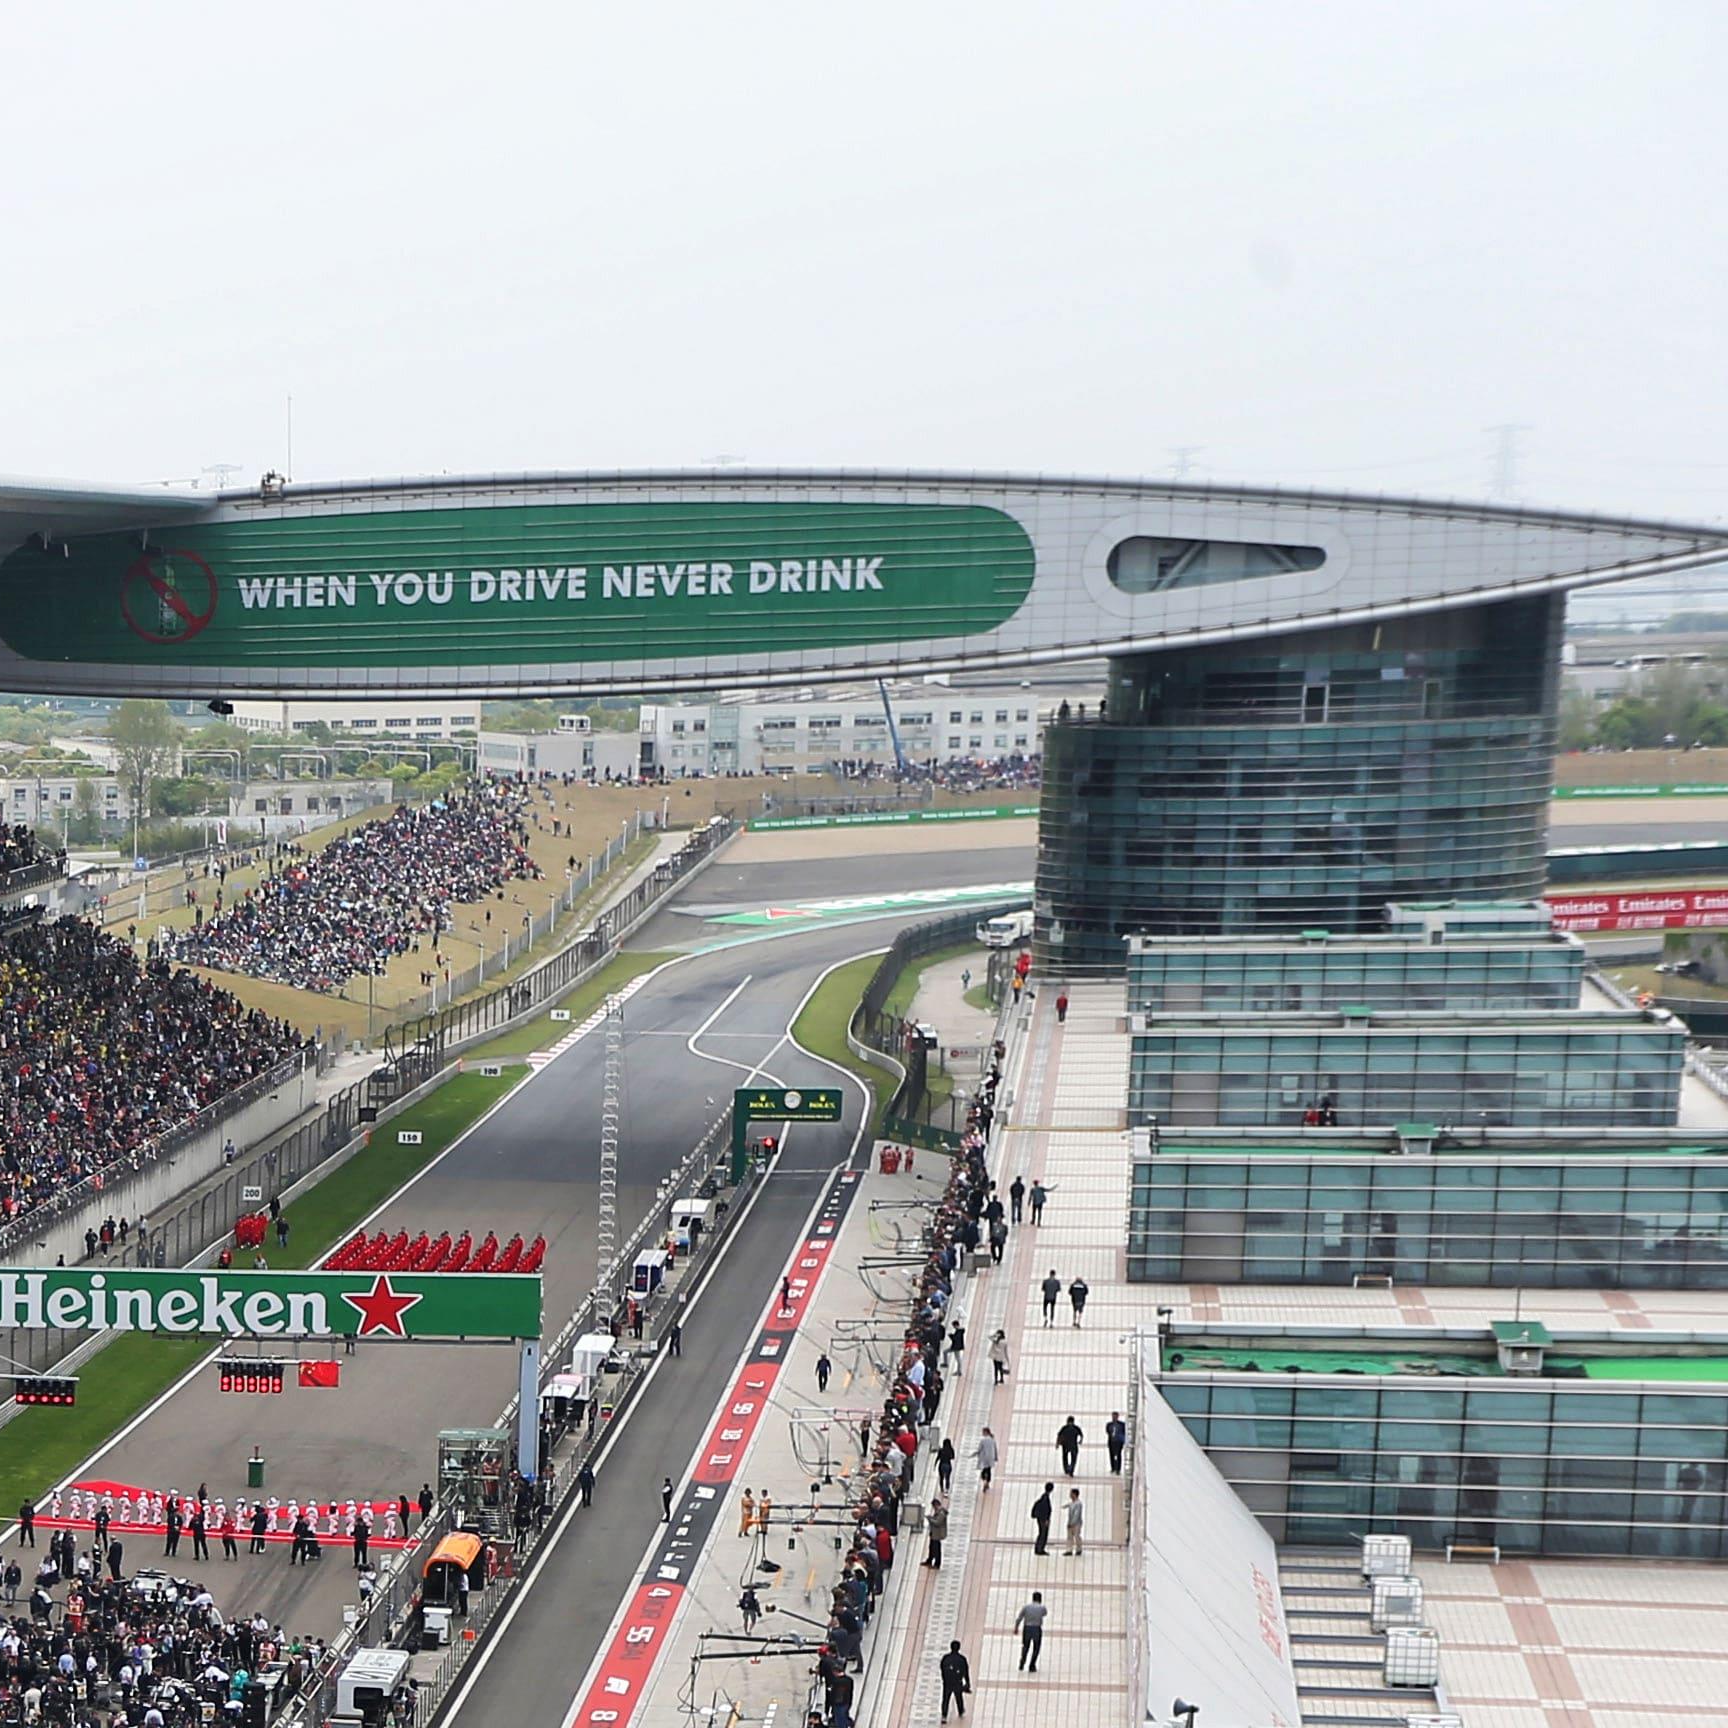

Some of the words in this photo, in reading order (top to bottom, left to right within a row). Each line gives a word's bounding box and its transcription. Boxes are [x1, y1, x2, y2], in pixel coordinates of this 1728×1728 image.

[238, 575, 356, 609] WHEN
[369, 572, 455, 606] YOU
[470, 567, 587, 602] DRIVE
[603, 562, 734, 599] NEVER
[748, 557, 885, 594] DRINK
[1617, 897, 1686, 913] Emirates
[401, 1132, 418, 1143] 150
[244, 1187, 261, 1200] 200
